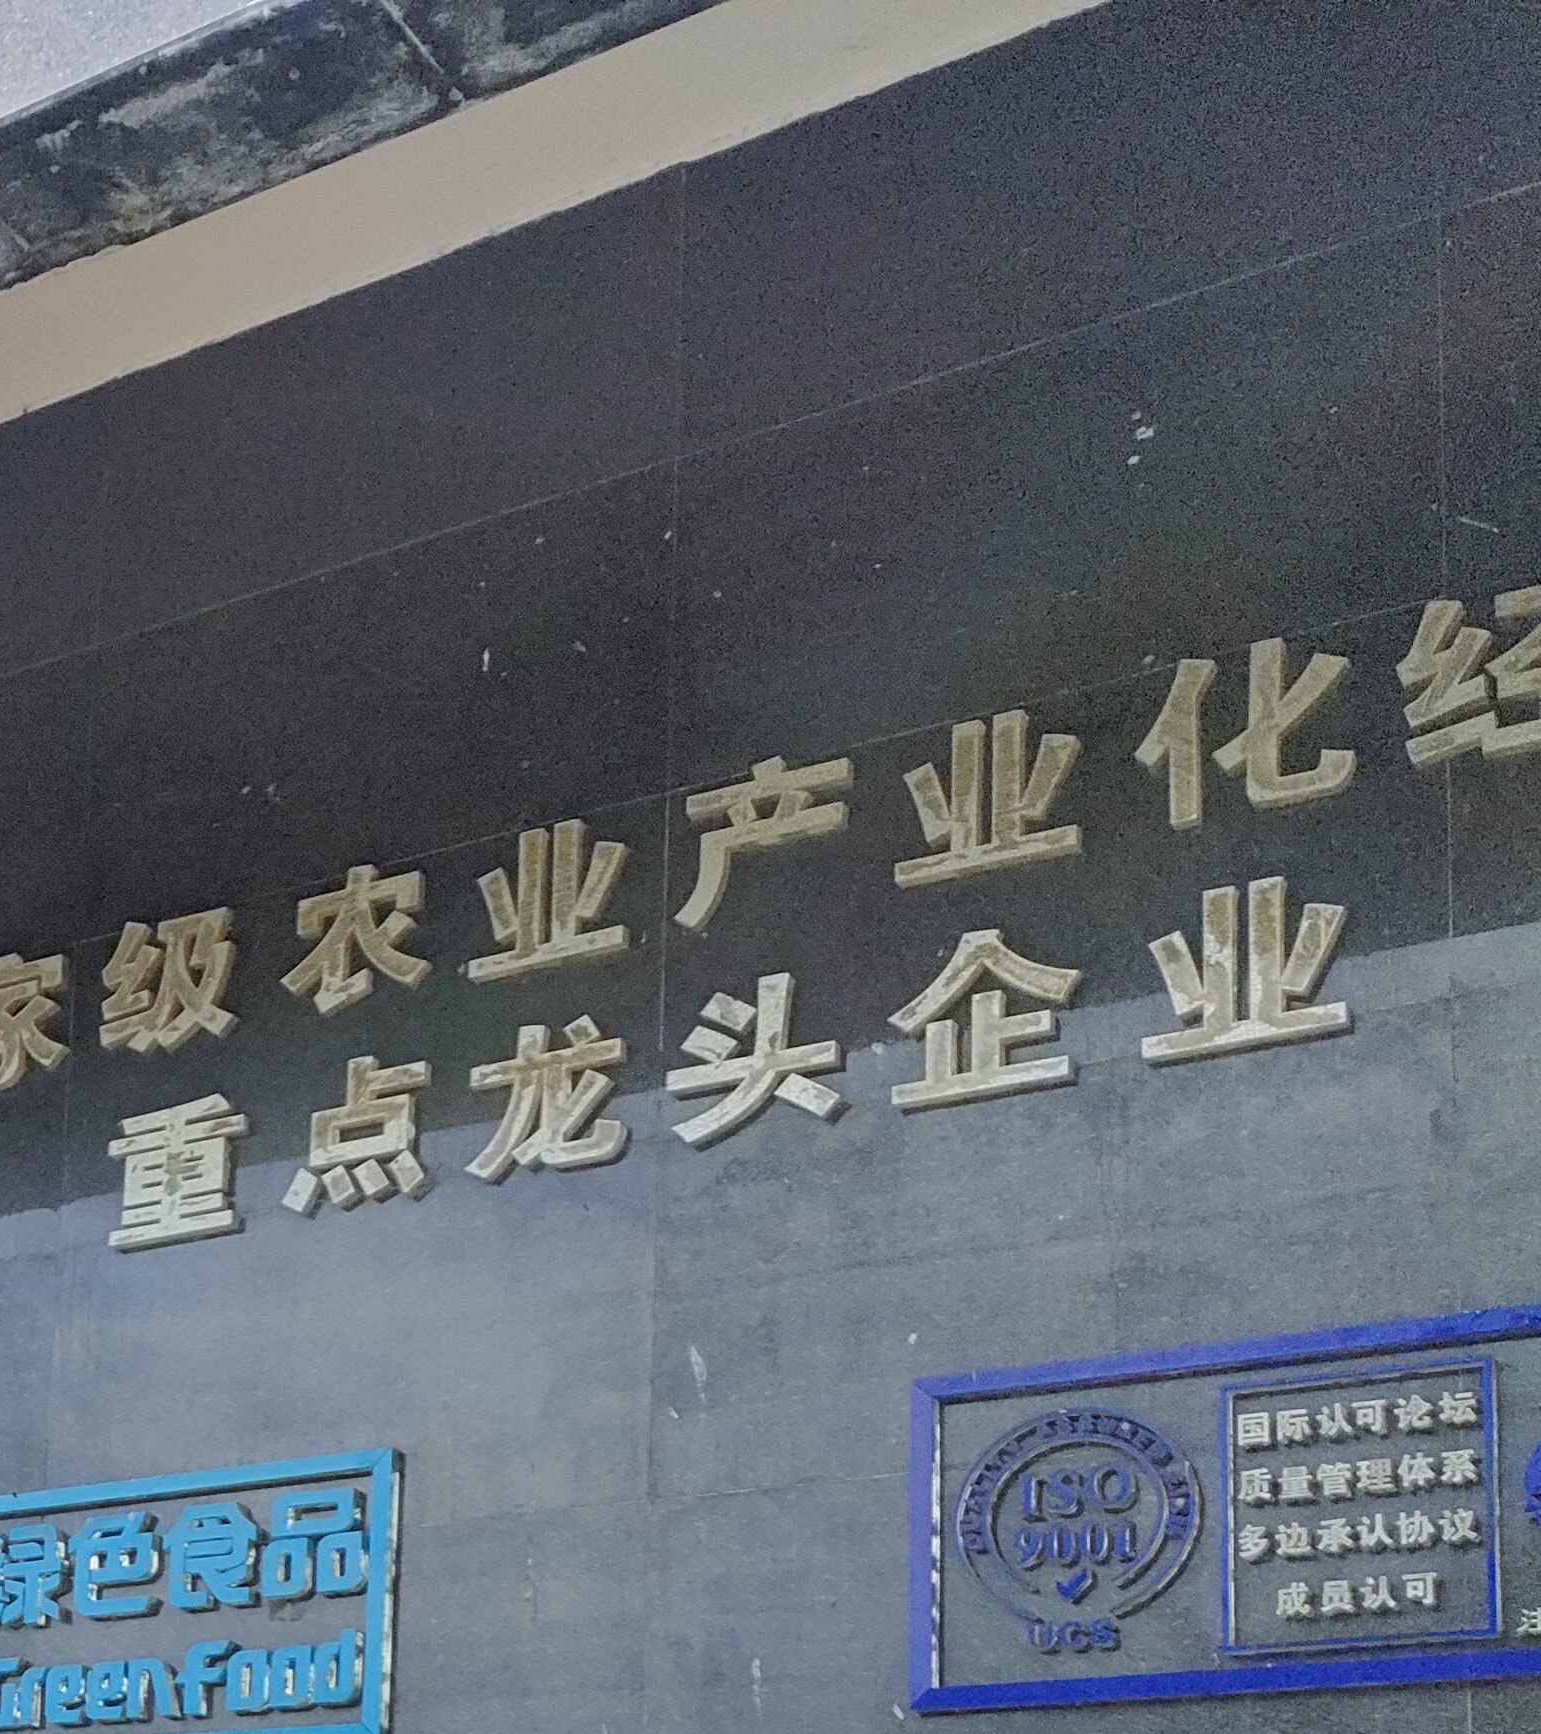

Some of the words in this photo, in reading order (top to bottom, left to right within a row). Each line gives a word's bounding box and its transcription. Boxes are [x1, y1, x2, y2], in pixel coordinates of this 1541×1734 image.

[108, 877, 1351, 1253] 重点龙头企业
[1237, 1391, 1479, 1448] 国际认可论坛
[1020, 1466, 1137, 1522] ISO
[1237, 1449, 1479, 1502] 质量管理体系
[1014, 1519, 1136, 1571] 9001
[1238, 1508, 1482, 1561] 多边承认协议
[1275, 1571, 1439, 1617] 成员认可
